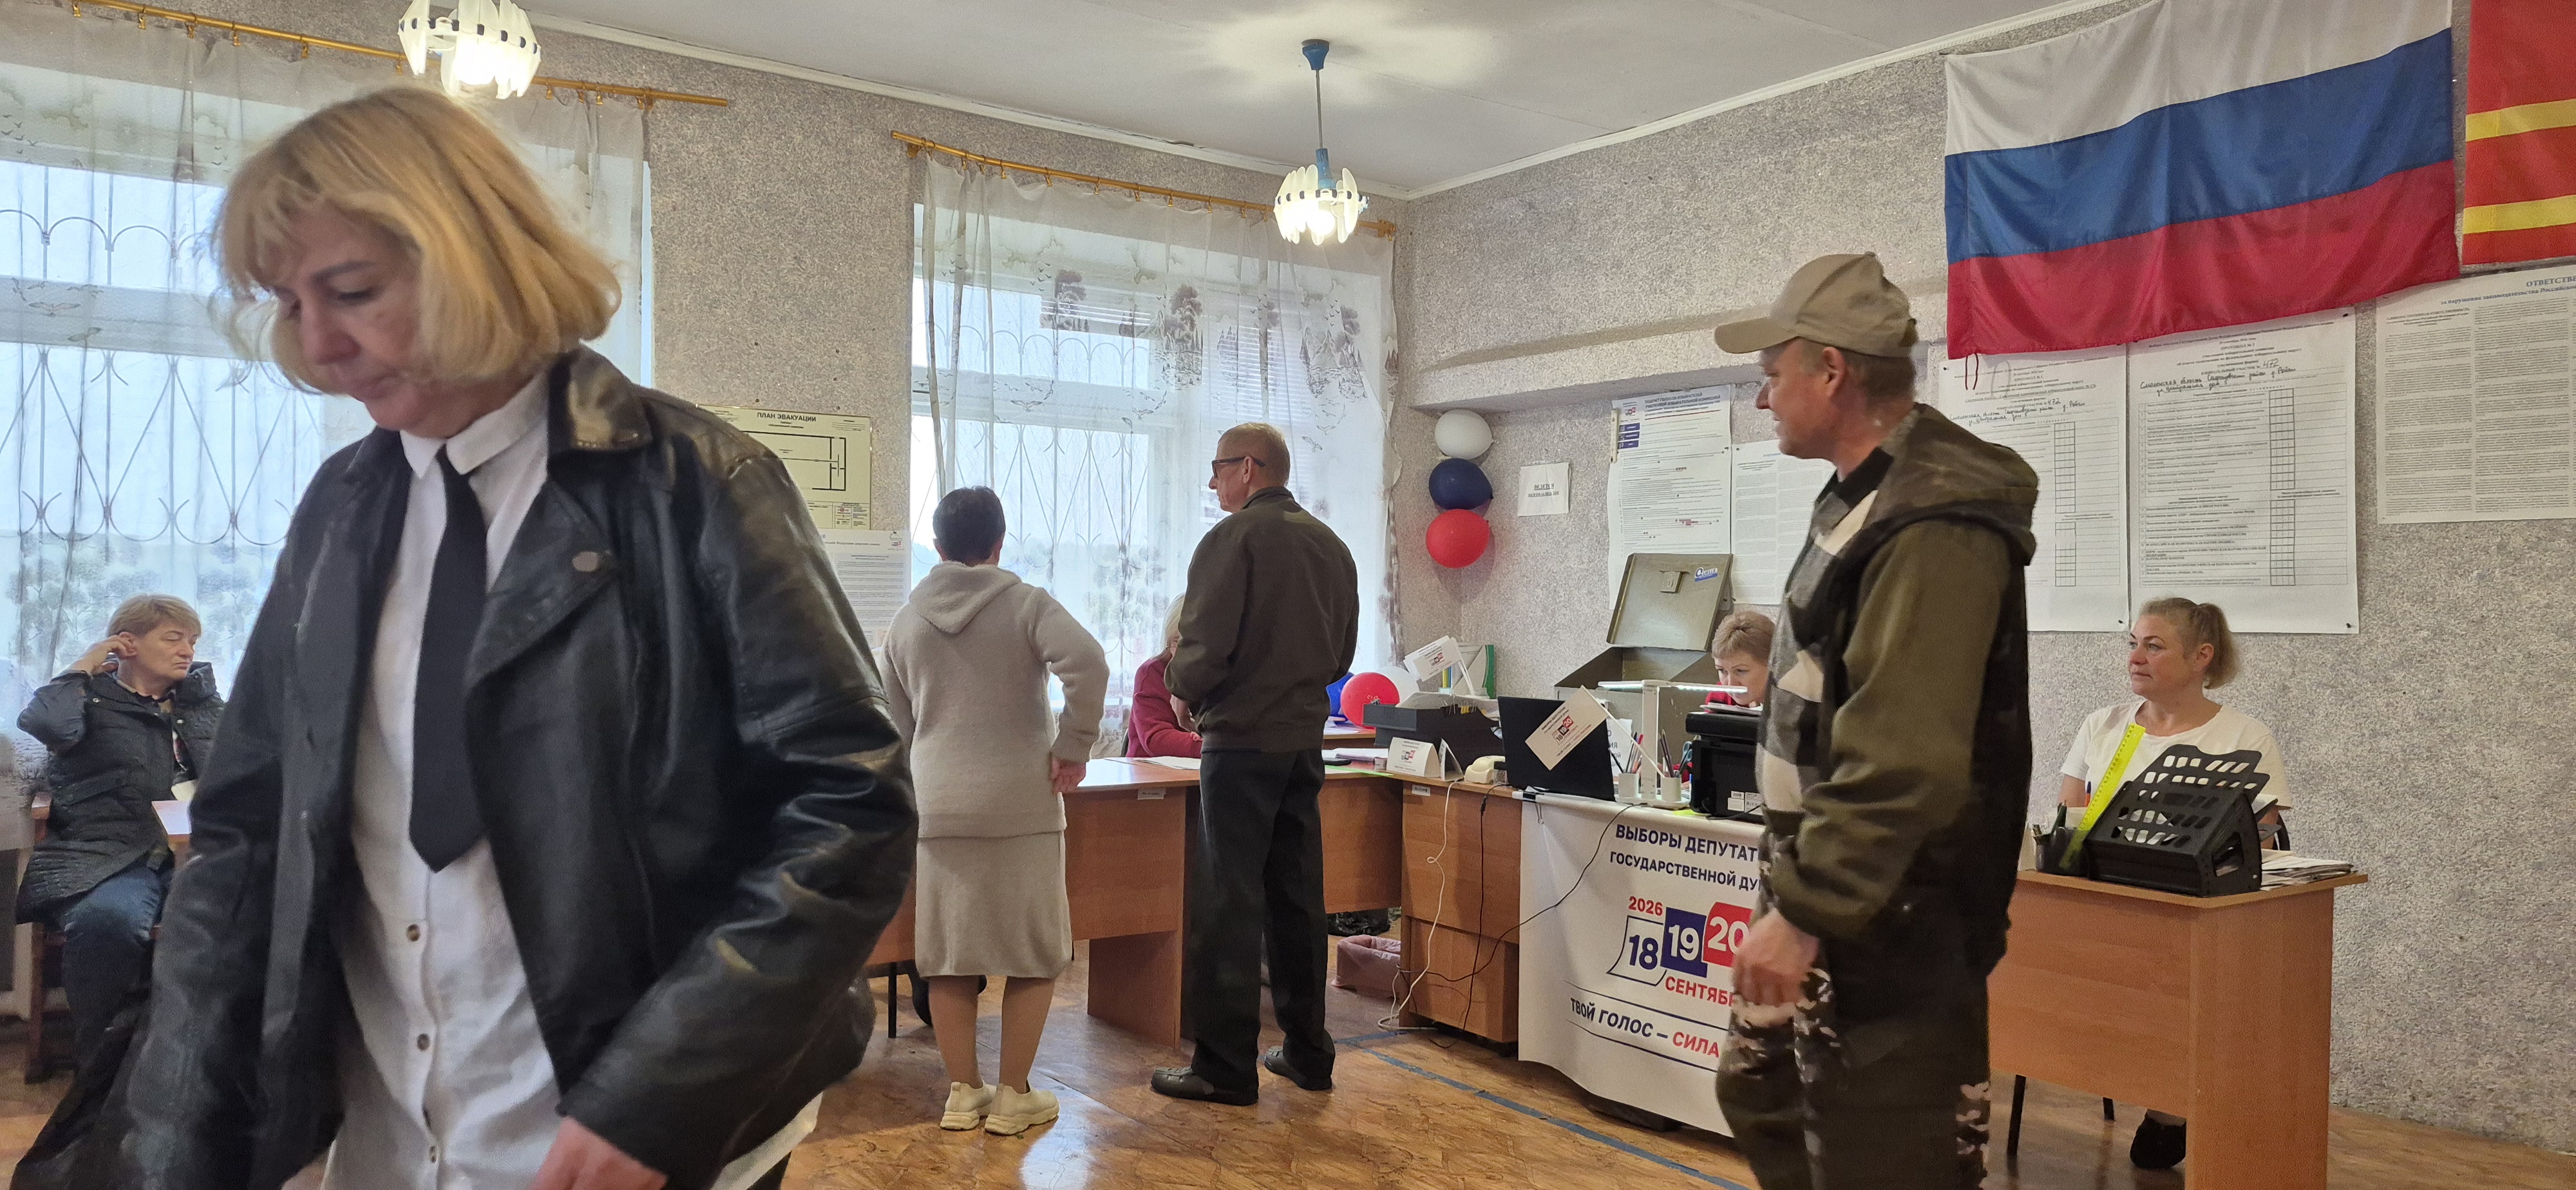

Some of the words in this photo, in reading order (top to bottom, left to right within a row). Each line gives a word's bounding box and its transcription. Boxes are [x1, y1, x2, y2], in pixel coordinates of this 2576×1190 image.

[2263, 358, 2280, 368] 472
[1559, 726, 1567, 734] 19
[1563, 717, 1572, 726] 20
[1616, 824, 1681, 849] ВЫБОРЫ
[1685, 836, 1761, 862] ДЕПУТАТ
[1610, 851, 1736, 887] ГОСУДАРСТВЕННОЙ
[1739, 876, 1761, 892] ДУ
[1629, 896, 1663, 916] 2026
[1629, 934, 1658, 970] 18
[1669, 925, 1700, 961] 19
[1707, 916, 1750, 954] 20
[1570, 997, 1596, 1021] ТВОЙ
[1598, 1009, 1653, 1037] ГОЛОС
[1672, 1032, 1719, 1058] СИЛА
